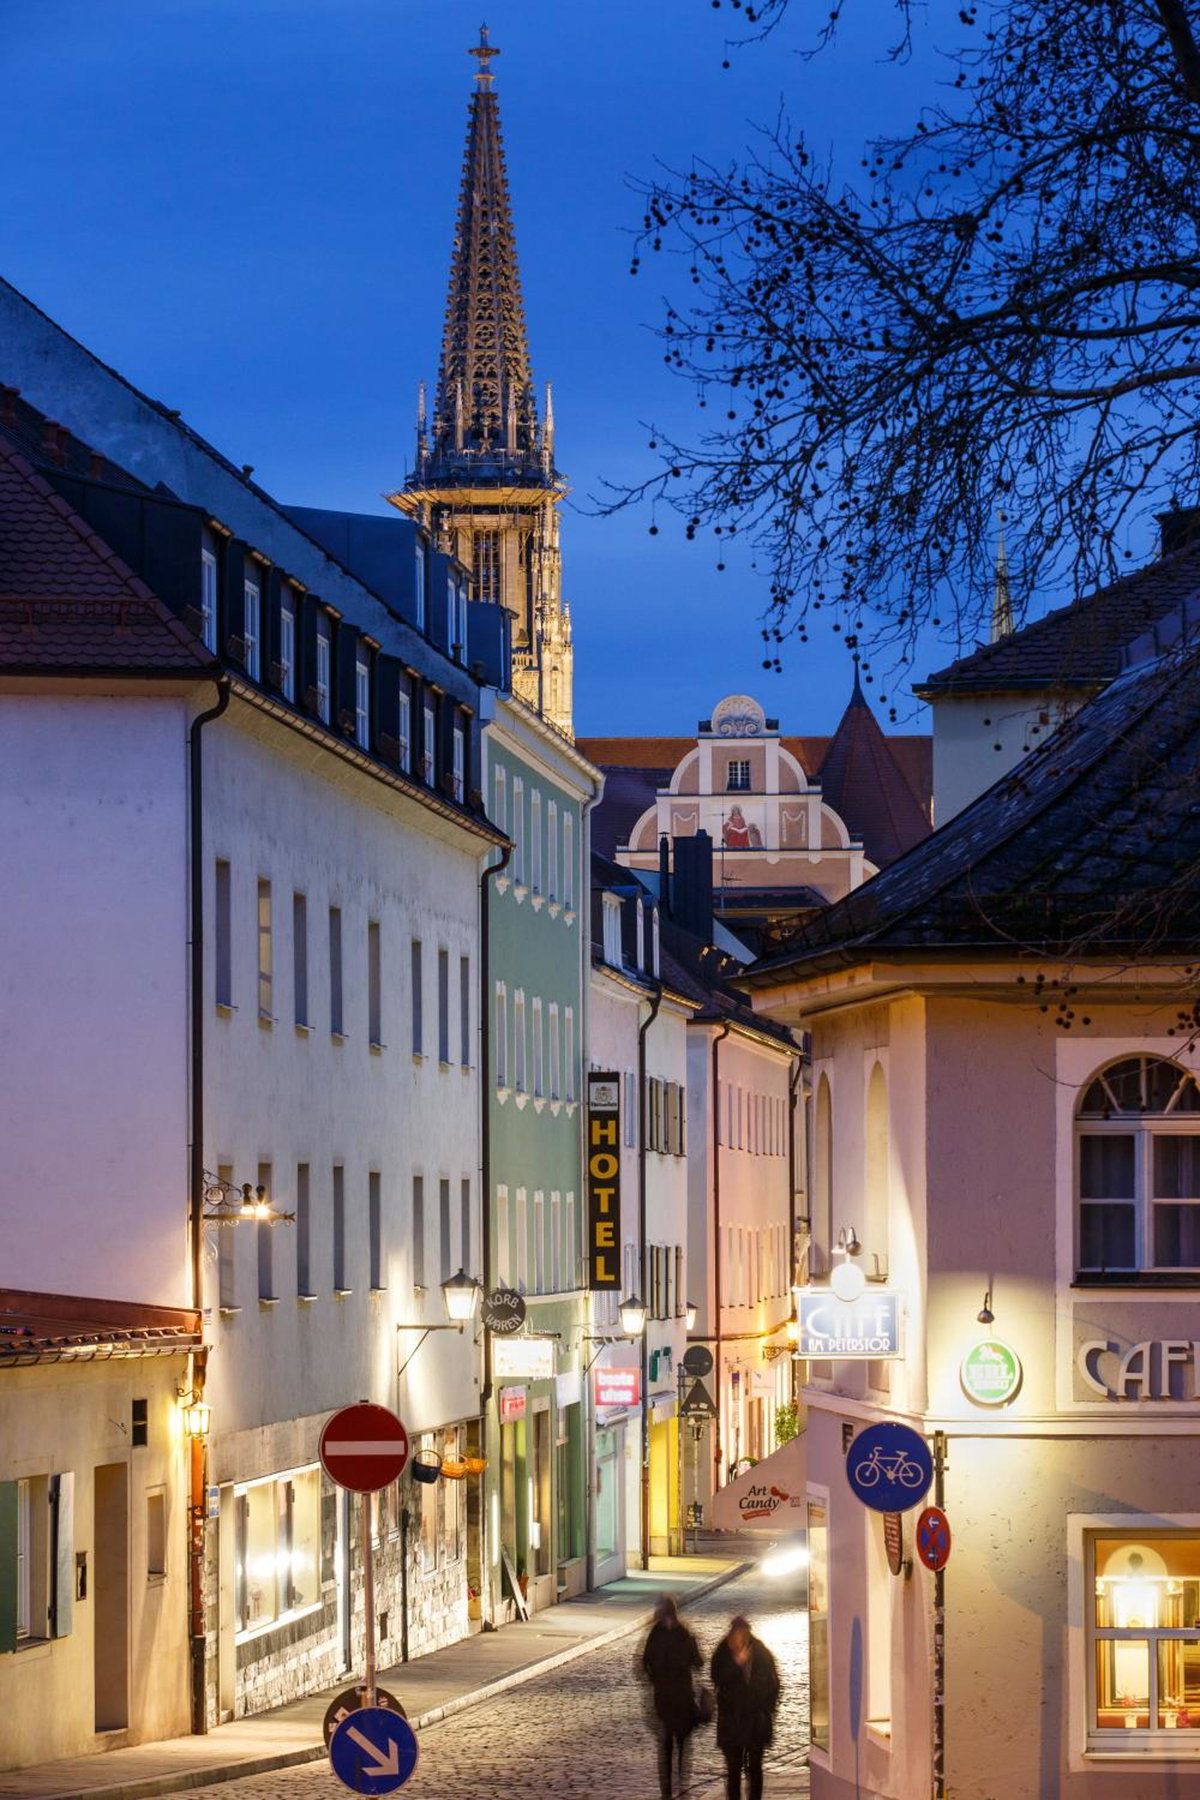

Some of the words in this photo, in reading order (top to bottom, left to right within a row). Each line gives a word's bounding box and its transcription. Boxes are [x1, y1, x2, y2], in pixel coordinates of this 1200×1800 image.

[590, 1120, 618, 1281] HOTEL
[487, 1294, 519, 1309] KORB
[485, 1313, 522, 1331] WAREN
[808, 1338, 824, 1352] AM
[829, 1337, 891, 1352] PETERSTOR
[748, 1485, 767, 1496] Art
[739, 1497, 779, 1511] Candy
